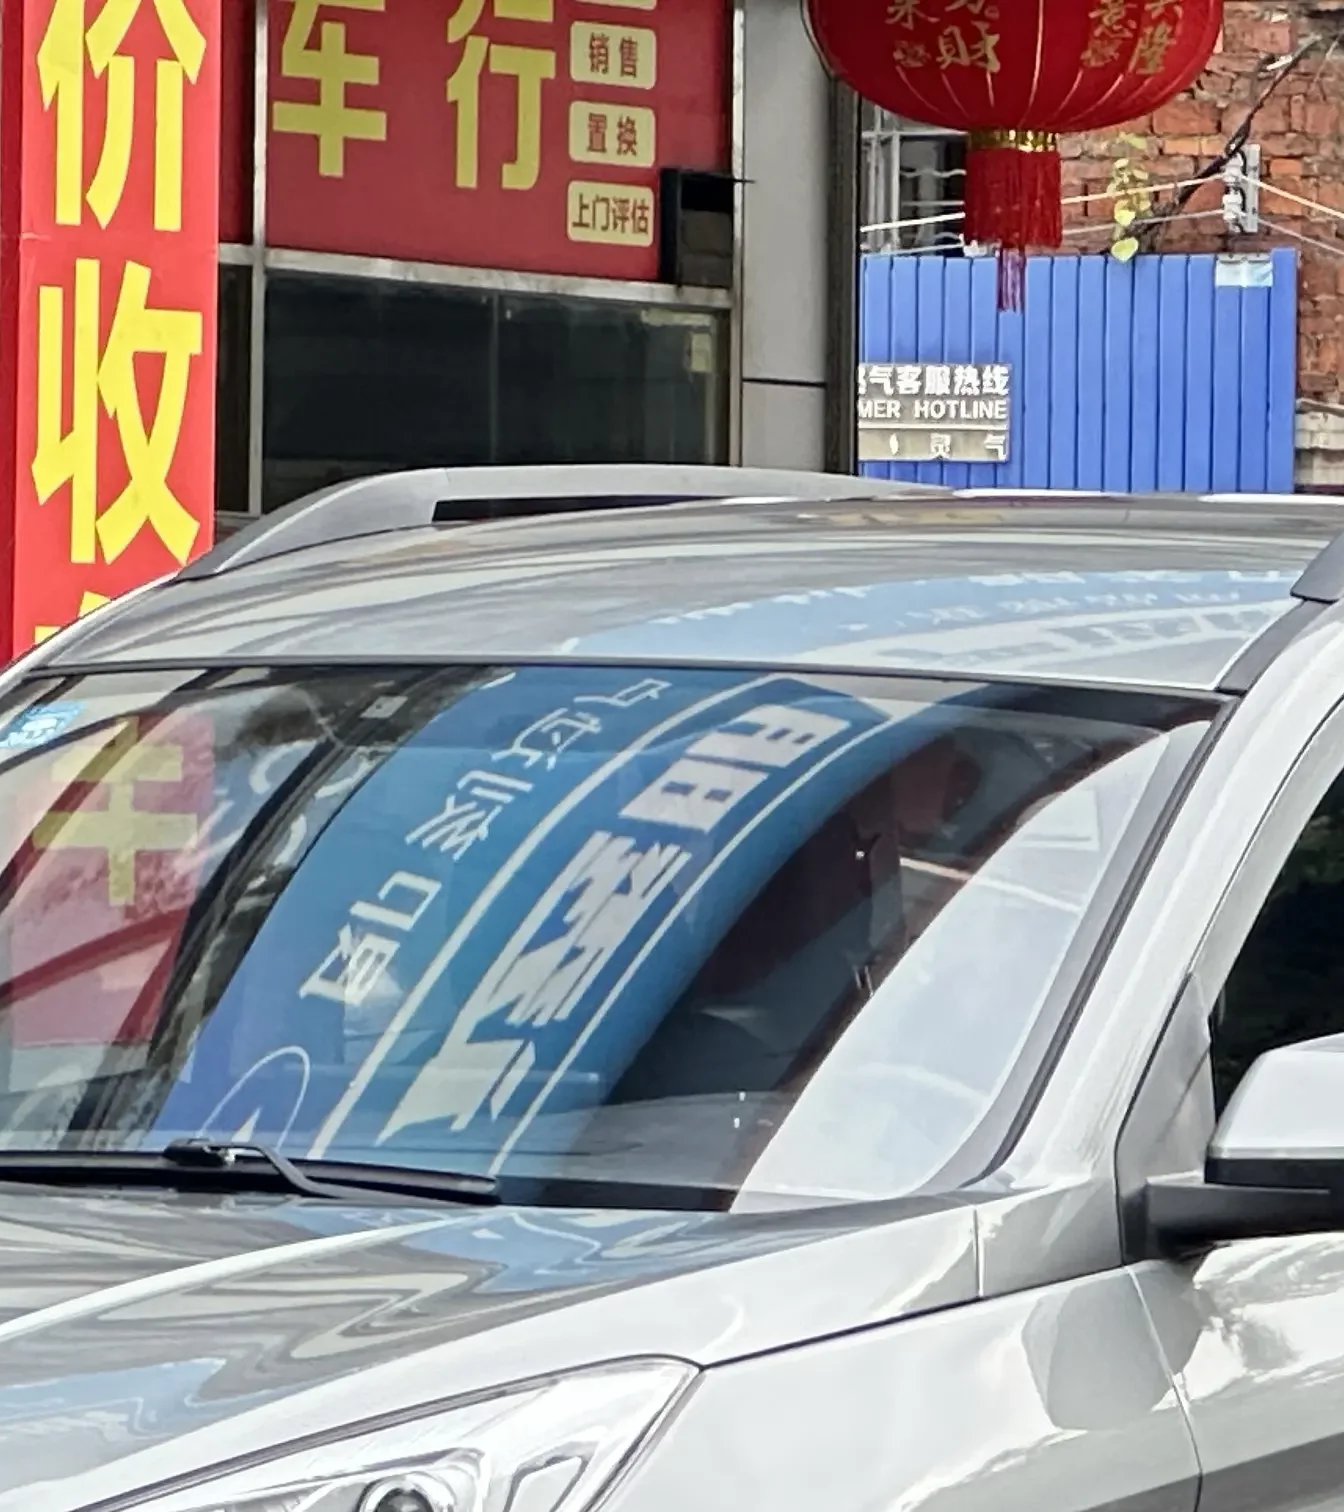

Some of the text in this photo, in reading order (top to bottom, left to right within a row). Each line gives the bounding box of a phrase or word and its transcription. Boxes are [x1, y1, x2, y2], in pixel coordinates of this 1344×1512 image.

[588, 32, 638, 78] 销售
[272, 0, 556, 190] 车行
[587, 112, 638, 157] 置换
[572, 193, 649, 234] 上门评估
[913, 399, 1008, 420] HOTLINE
